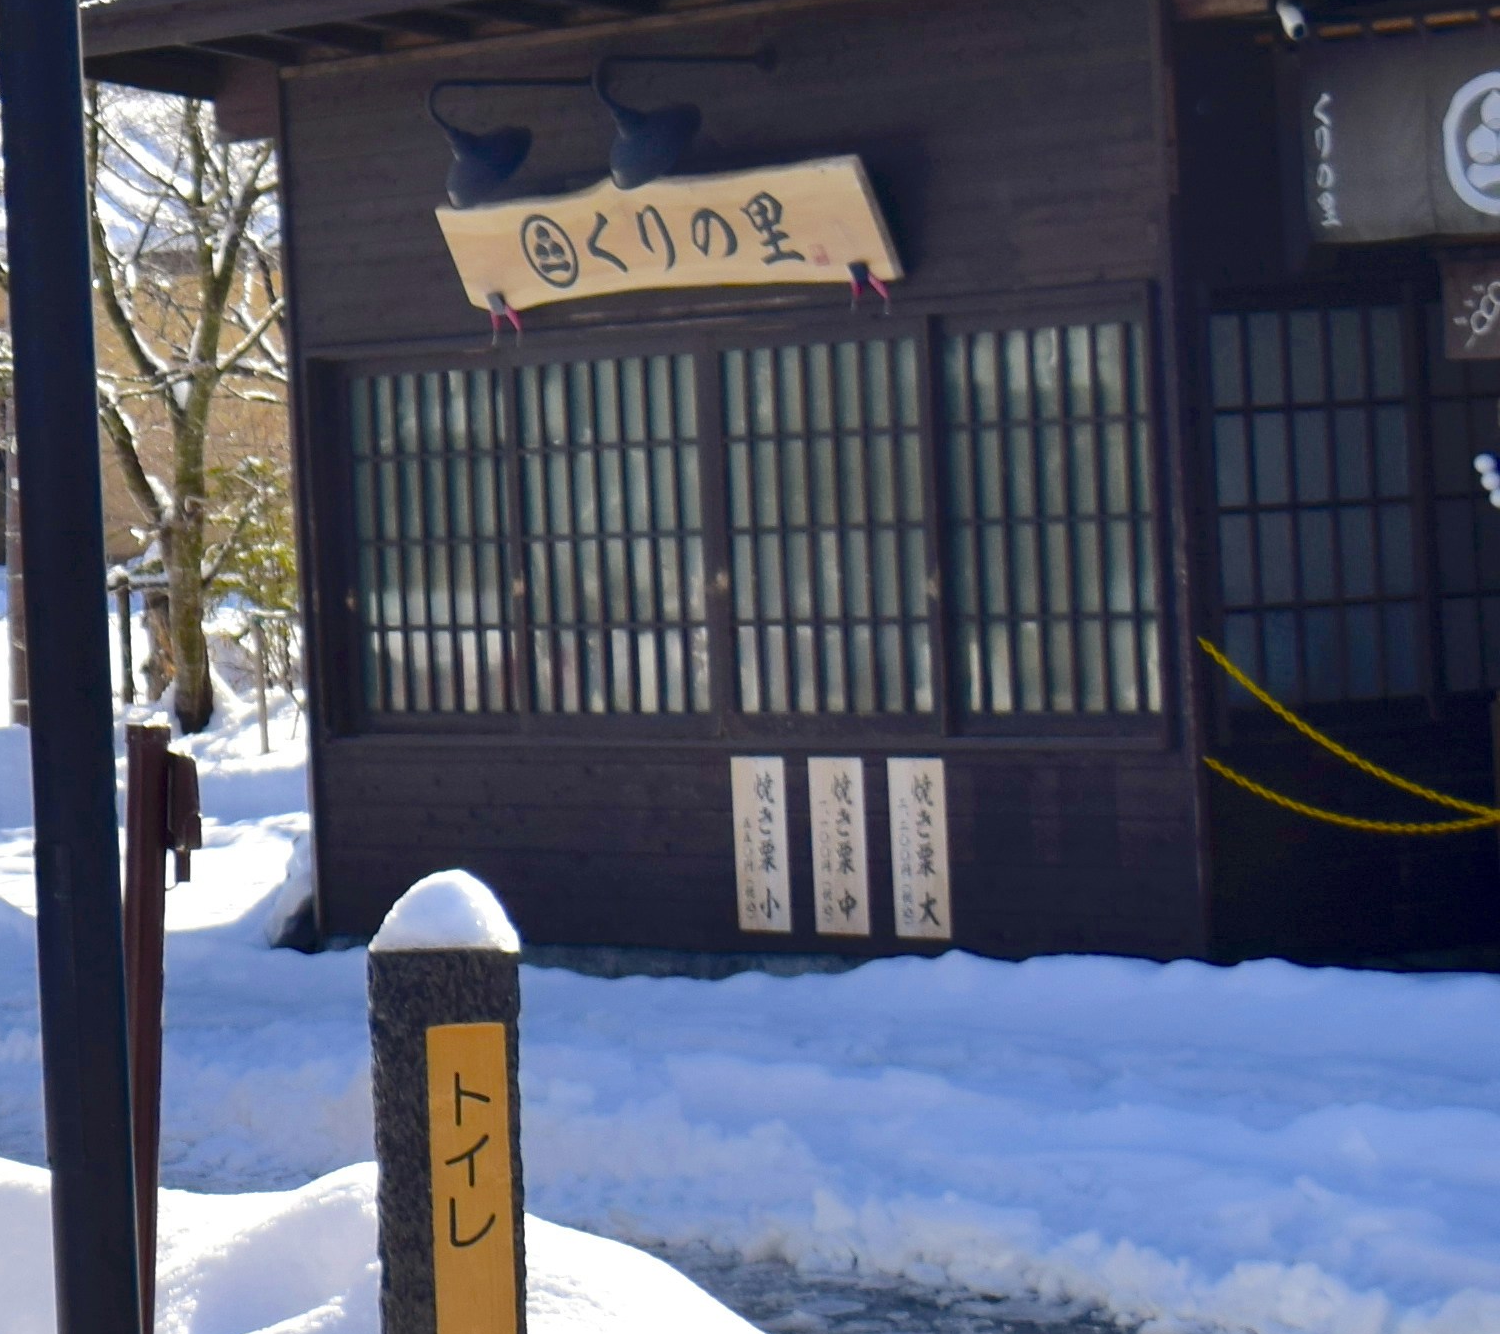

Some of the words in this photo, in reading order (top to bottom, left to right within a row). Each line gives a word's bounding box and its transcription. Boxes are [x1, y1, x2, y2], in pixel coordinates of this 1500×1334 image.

[586, 190, 805, 273] くりの里
[445, 1071, 495, 1247] トイレ
